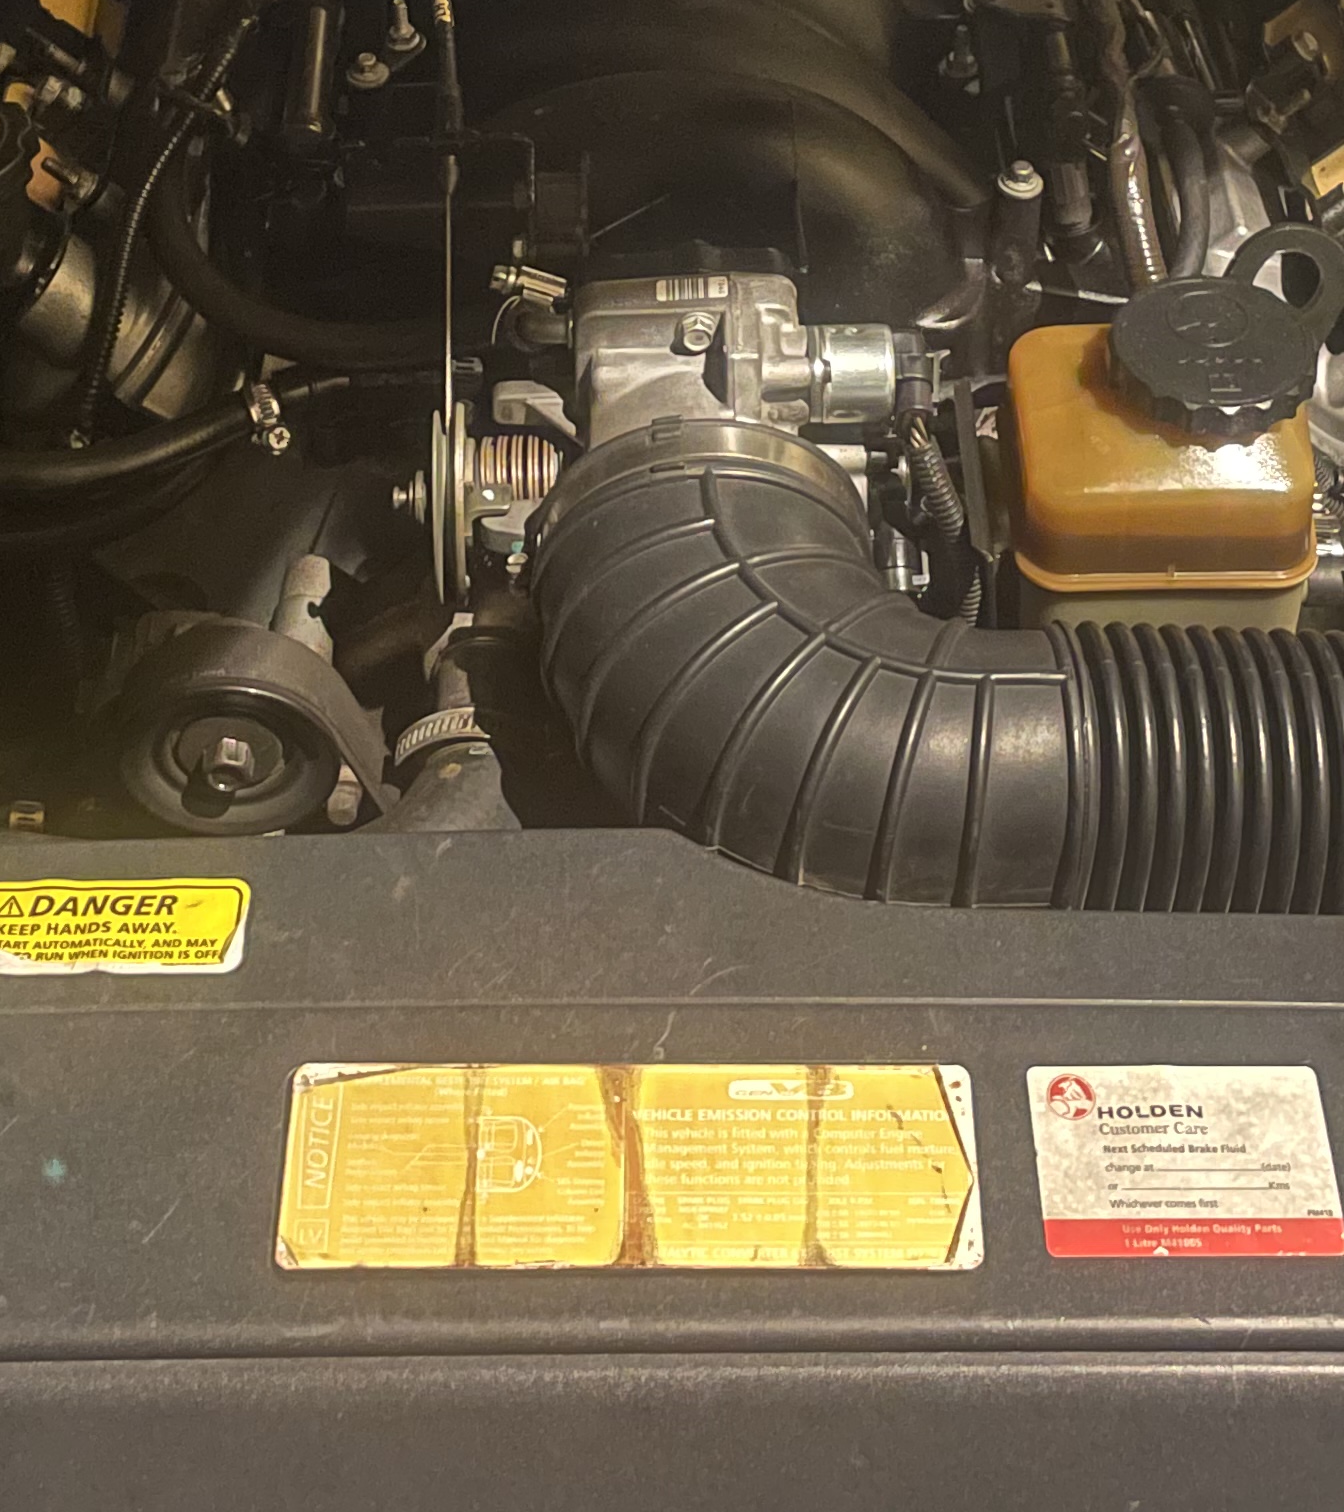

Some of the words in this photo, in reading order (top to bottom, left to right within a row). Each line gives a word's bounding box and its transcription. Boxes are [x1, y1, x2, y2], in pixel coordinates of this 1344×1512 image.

[28, 894, 179, 917] DANGER
[45, 921, 112, 936] HANDS
[117, 921, 179, 935] AWAY.
[151, 938, 182, 948] AND
[186, 938, 218, 948] MAY
[35, 950, 65, 961] RUN
[68, 949, 109, 960] WHEN
[111, 949, 175, 959] IGNITION
[178, 949, 191, 959] IS
[632, 1108, 693, 1122] VEHICLE
[698, 1108, 772, 1122] EMISSION
[775, 1108, 847, 1122] CONTROL
[851, 1108, 949, 1122] INFORMATIO
[1097, 1104, 1204, 1119] HOLDEN
[671, 1127, 715, 1139] vehicle
[718, 1128, 728, 1139] is
[732, 1127, 766, 1139] fitted
[769, 1128, 798, 1139] with
[814, 1128, 877, 1141] Computer
[879, 1127, 923, 1142] Engine
[1098, 1122, 1169, 1136] Customer
[1173, 1121, 1209, 1135] Care
[304, 1095, 334, 1190] NOTICE
[1103, 1144, 1128, 1153] Next
[1130, 1143, 1185, 1153] Scheduled
[1188, 1144, 1218, 1153] Brake
[1220, 1143, 1247, 1153] Fluid
[643, 1143, 727, 1156] Management
[825, 1144, 878, 1155] controls
[880, 1144, 904, 1155] fuel
[715, 1159, 739, 1169] and
[743, 1158, 792, 1173] ignition
[844, 1159, 924, 1172] Adjustments
[1105, 1162, 1142, 1175] change
[1144, 1163, 1155, 1173] at
[1260, 1162, 1291, 1174] (date)
[681, 1173, 741, 1185] functions
[744, 1176, 764, 1185] are
[768, 1175, 790, 1185] not
[1108, 1183, 1119, 1191] or
[1109, 1199, 1163, 1210] Whichever
[1164, 1200, 1197, 1210] comes
[1199, 1198, 1219, 1209] first
[1122, 1224, 1143, 1234] Use
[1145, 1224, 1170, 1236] Only
[1172, 1224, 1210, 1234] Holden
[1212, 1224, 1252, 1236] Quality
[1254, 1224, 1283, 1234] Parts
